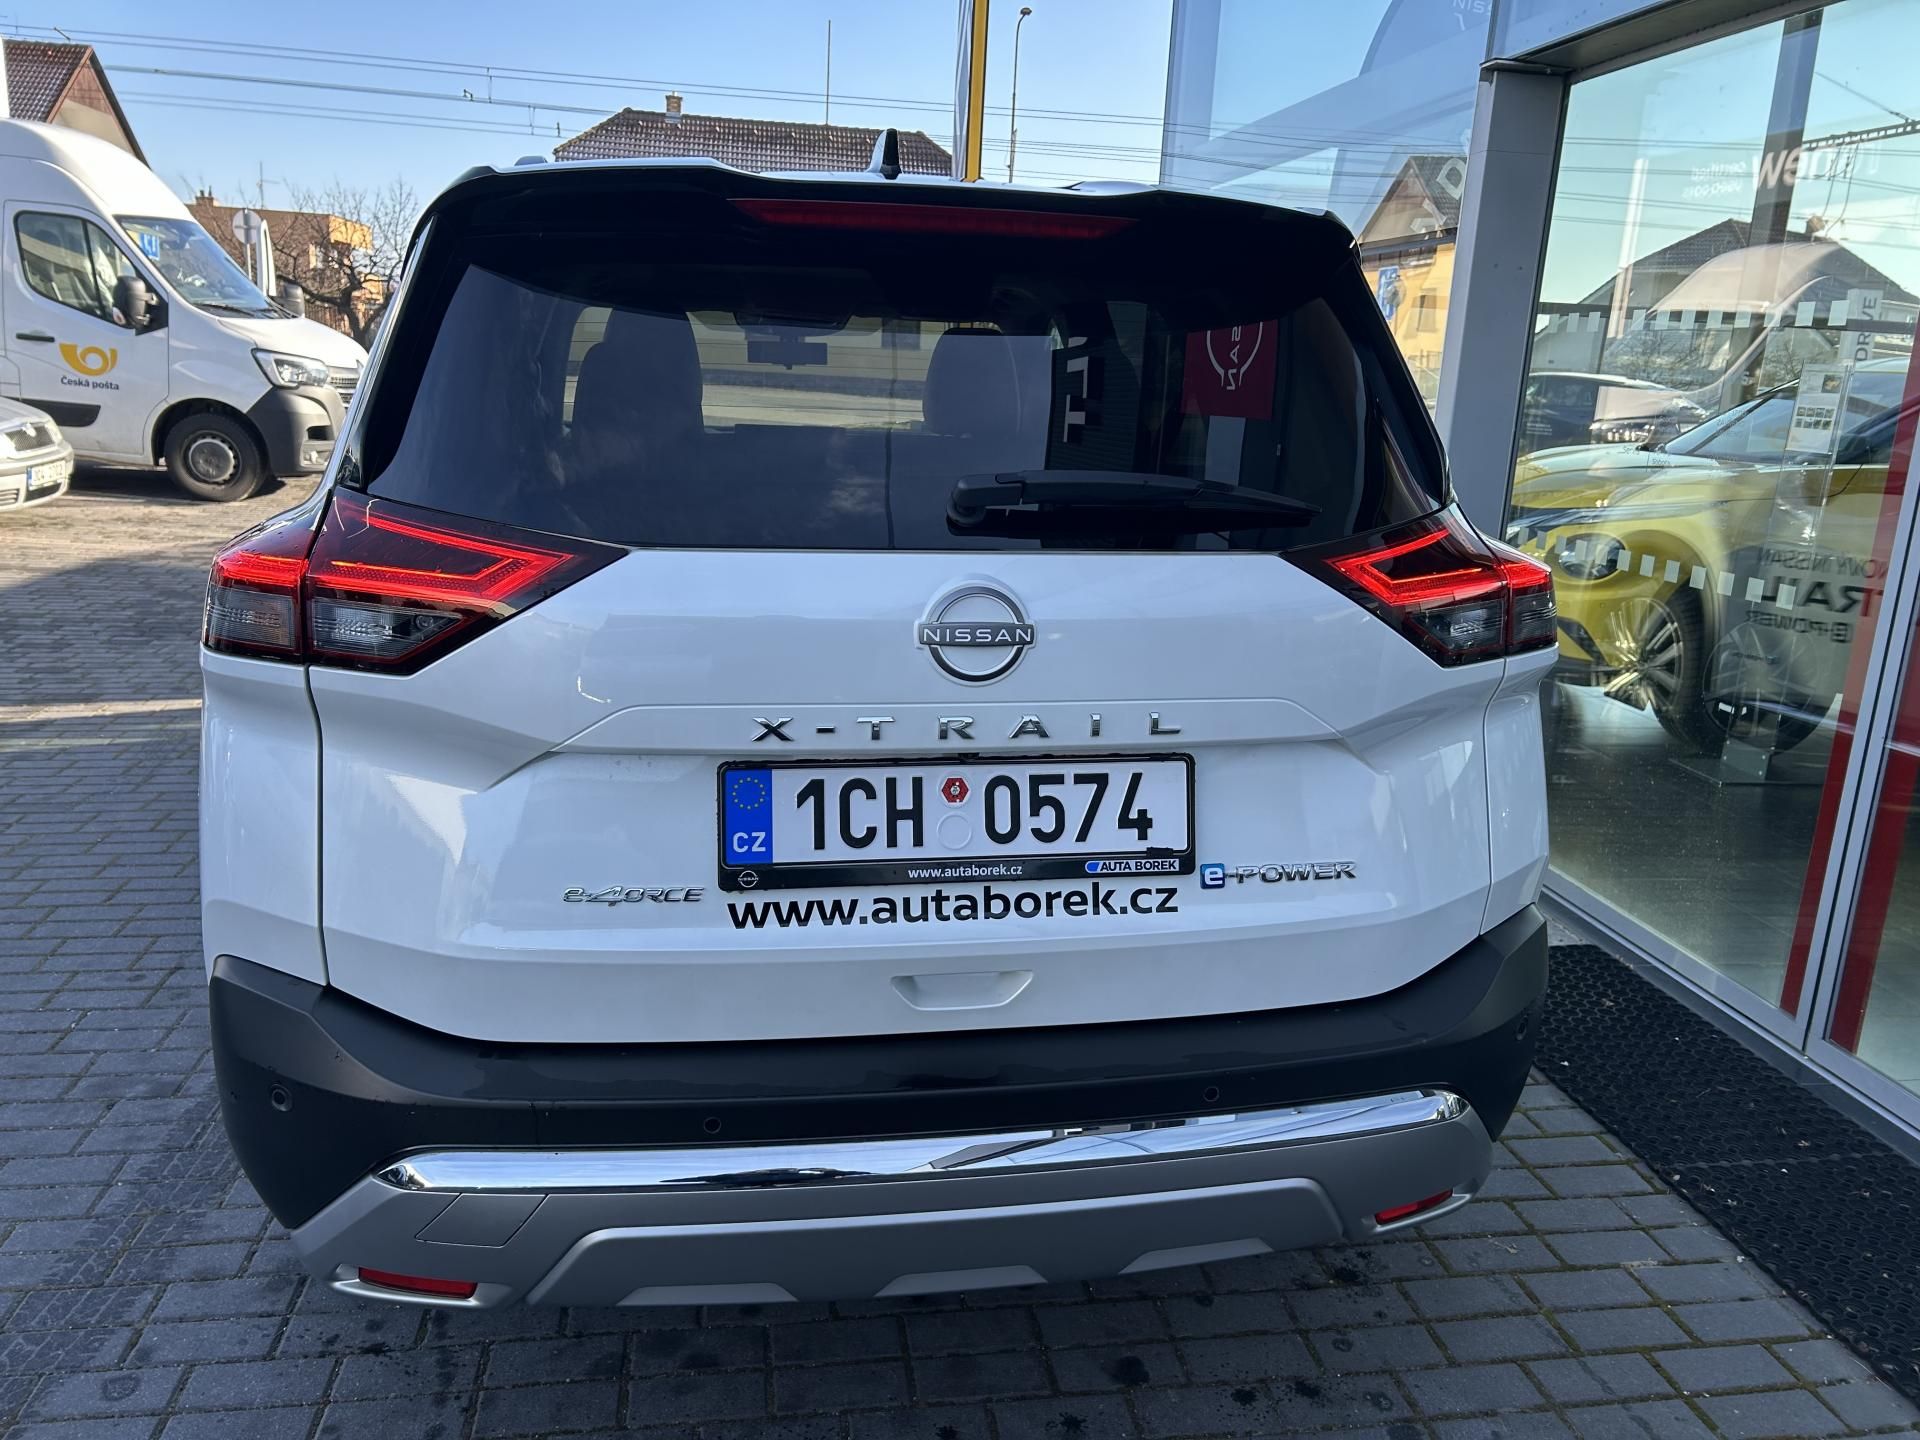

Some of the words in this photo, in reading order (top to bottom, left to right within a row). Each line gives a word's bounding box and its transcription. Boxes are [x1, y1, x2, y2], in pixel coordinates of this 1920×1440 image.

[1854, 296, 1878, 361] DRVE
[60, 375, 90, 388] Česká
[92, 381, 120, 391] pošta
[923, 628, 1031, 642] NISSAN
[796, 776, 924, 850] 1CH
[984, 771, 1154, 845] 0574
[732, 831, 767, 853] CZ
[908, 863, 1023, 879] www.autaborek.cz
[1100, 860, 1132, 873] AUTA
[1134, 859, 1177, 872] BOREK
[727, 882, 1179, 930] www.autaborek.cz
